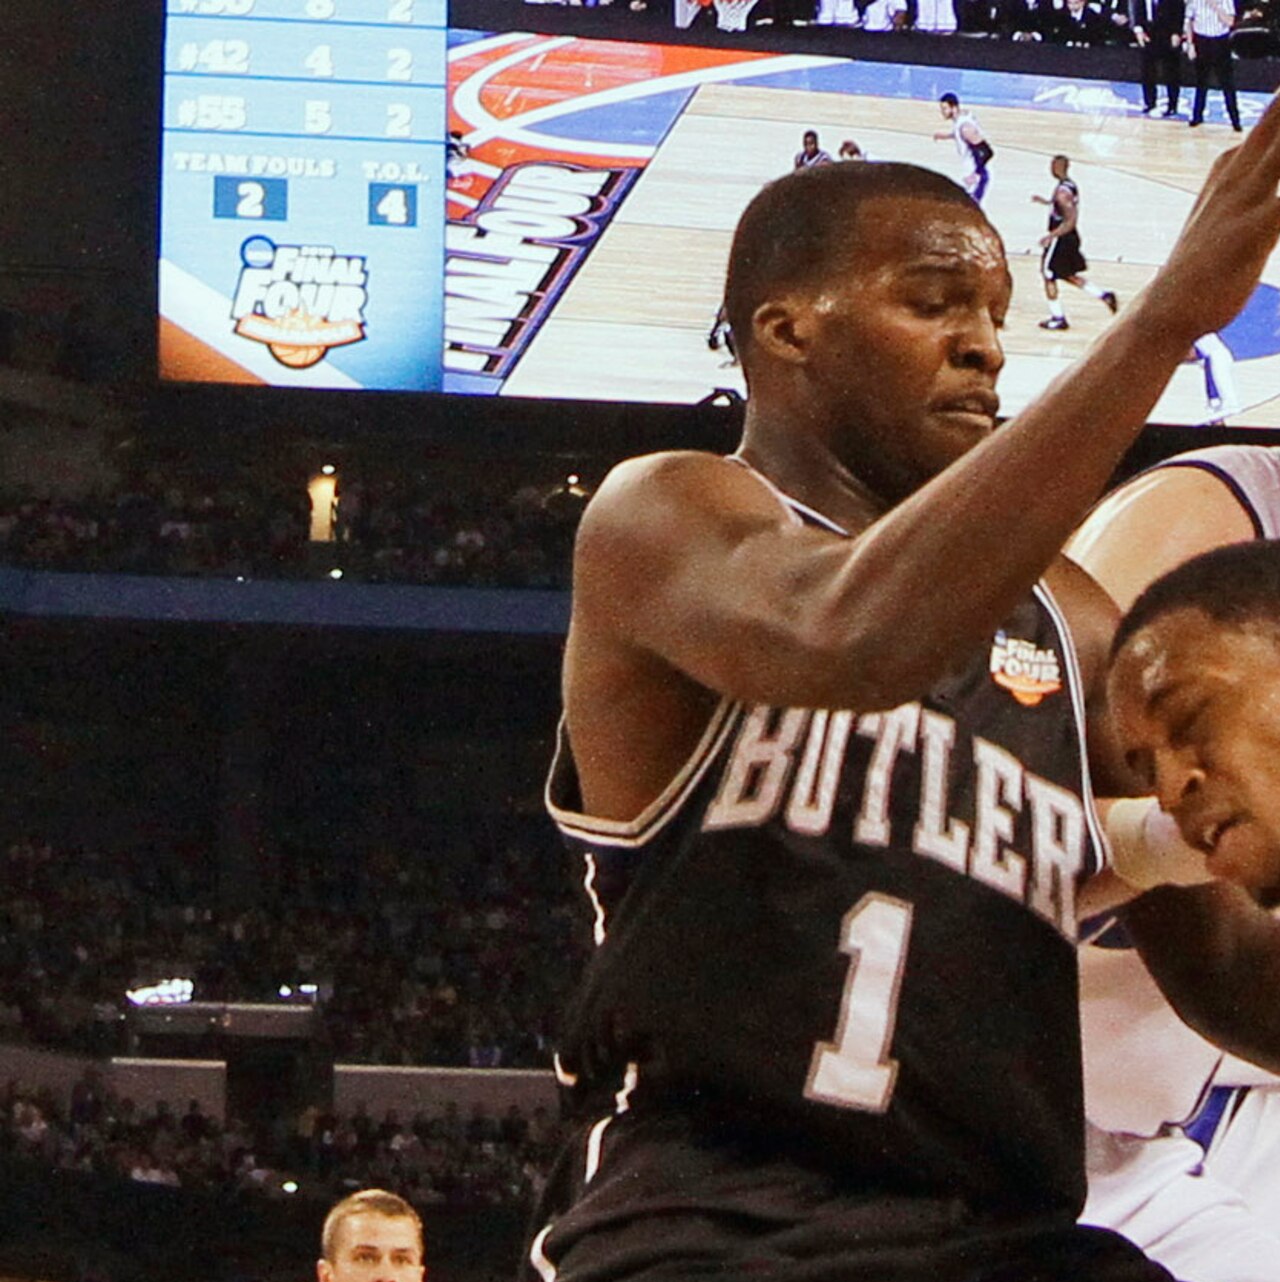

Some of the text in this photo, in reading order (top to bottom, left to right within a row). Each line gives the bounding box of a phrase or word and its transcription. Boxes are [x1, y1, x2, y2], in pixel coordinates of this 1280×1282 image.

[178, 40, 413, 81] #42 4 2
[178, 94, 412, 138] #55 5 2
[173, 153, 336, 178] TEAM FOULS
[363, 161, 430, 182] T.O.L.
[236, 182, 265, 218] 2
[376, 189, 409, 224] 4
[271, 246, 367, 285] FINAL
[231, 267, 367, 324] FOUR
[702, 702, 1087, 946] BUTLER
[803, 891, 914, 1114] 1
